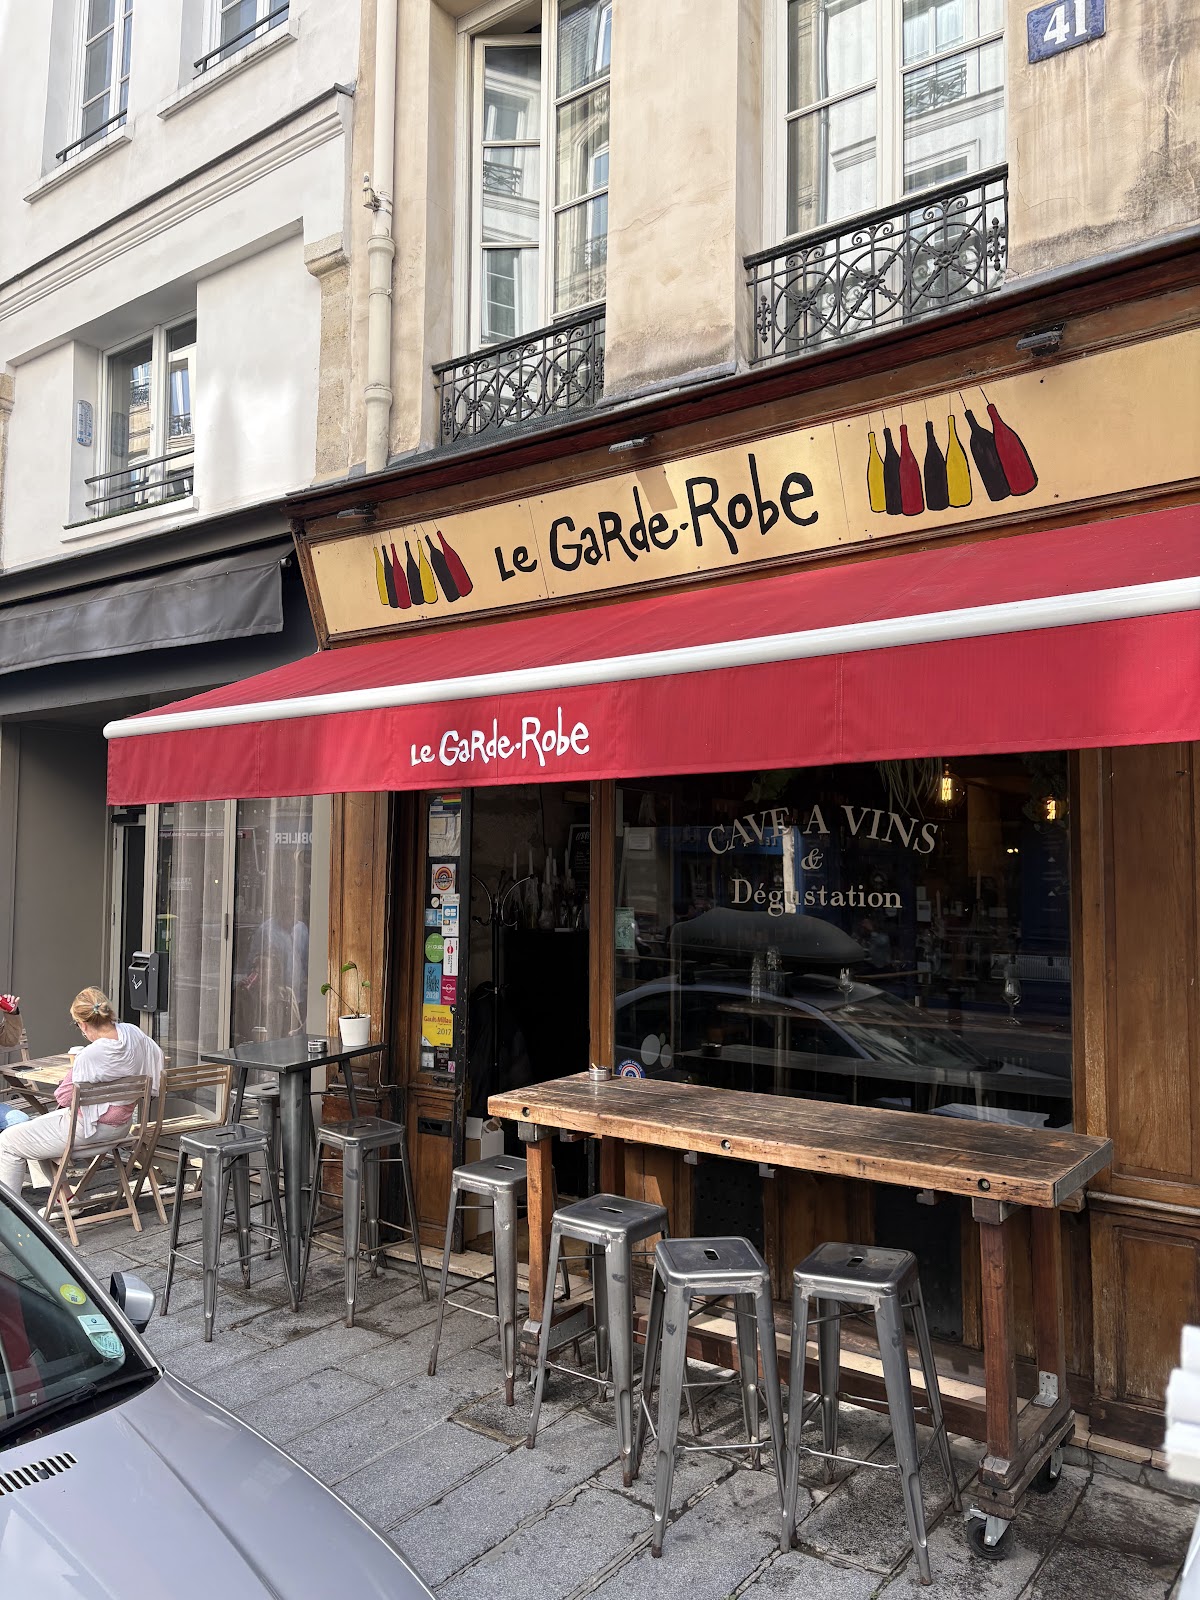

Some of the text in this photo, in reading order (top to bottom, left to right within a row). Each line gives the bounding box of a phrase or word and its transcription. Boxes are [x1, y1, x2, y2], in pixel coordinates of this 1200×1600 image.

[1043, 0, 1087, 45] 41
[494, 546, 538, 582] Le
[411, 744, 435, 766] Le
[707, 804, 938, 855] CAVE A VINS
[801, 848, 824, 870] &
[731, 878, 903, 917] Dégustation
[437, 1028, 452, 1036] 2017
